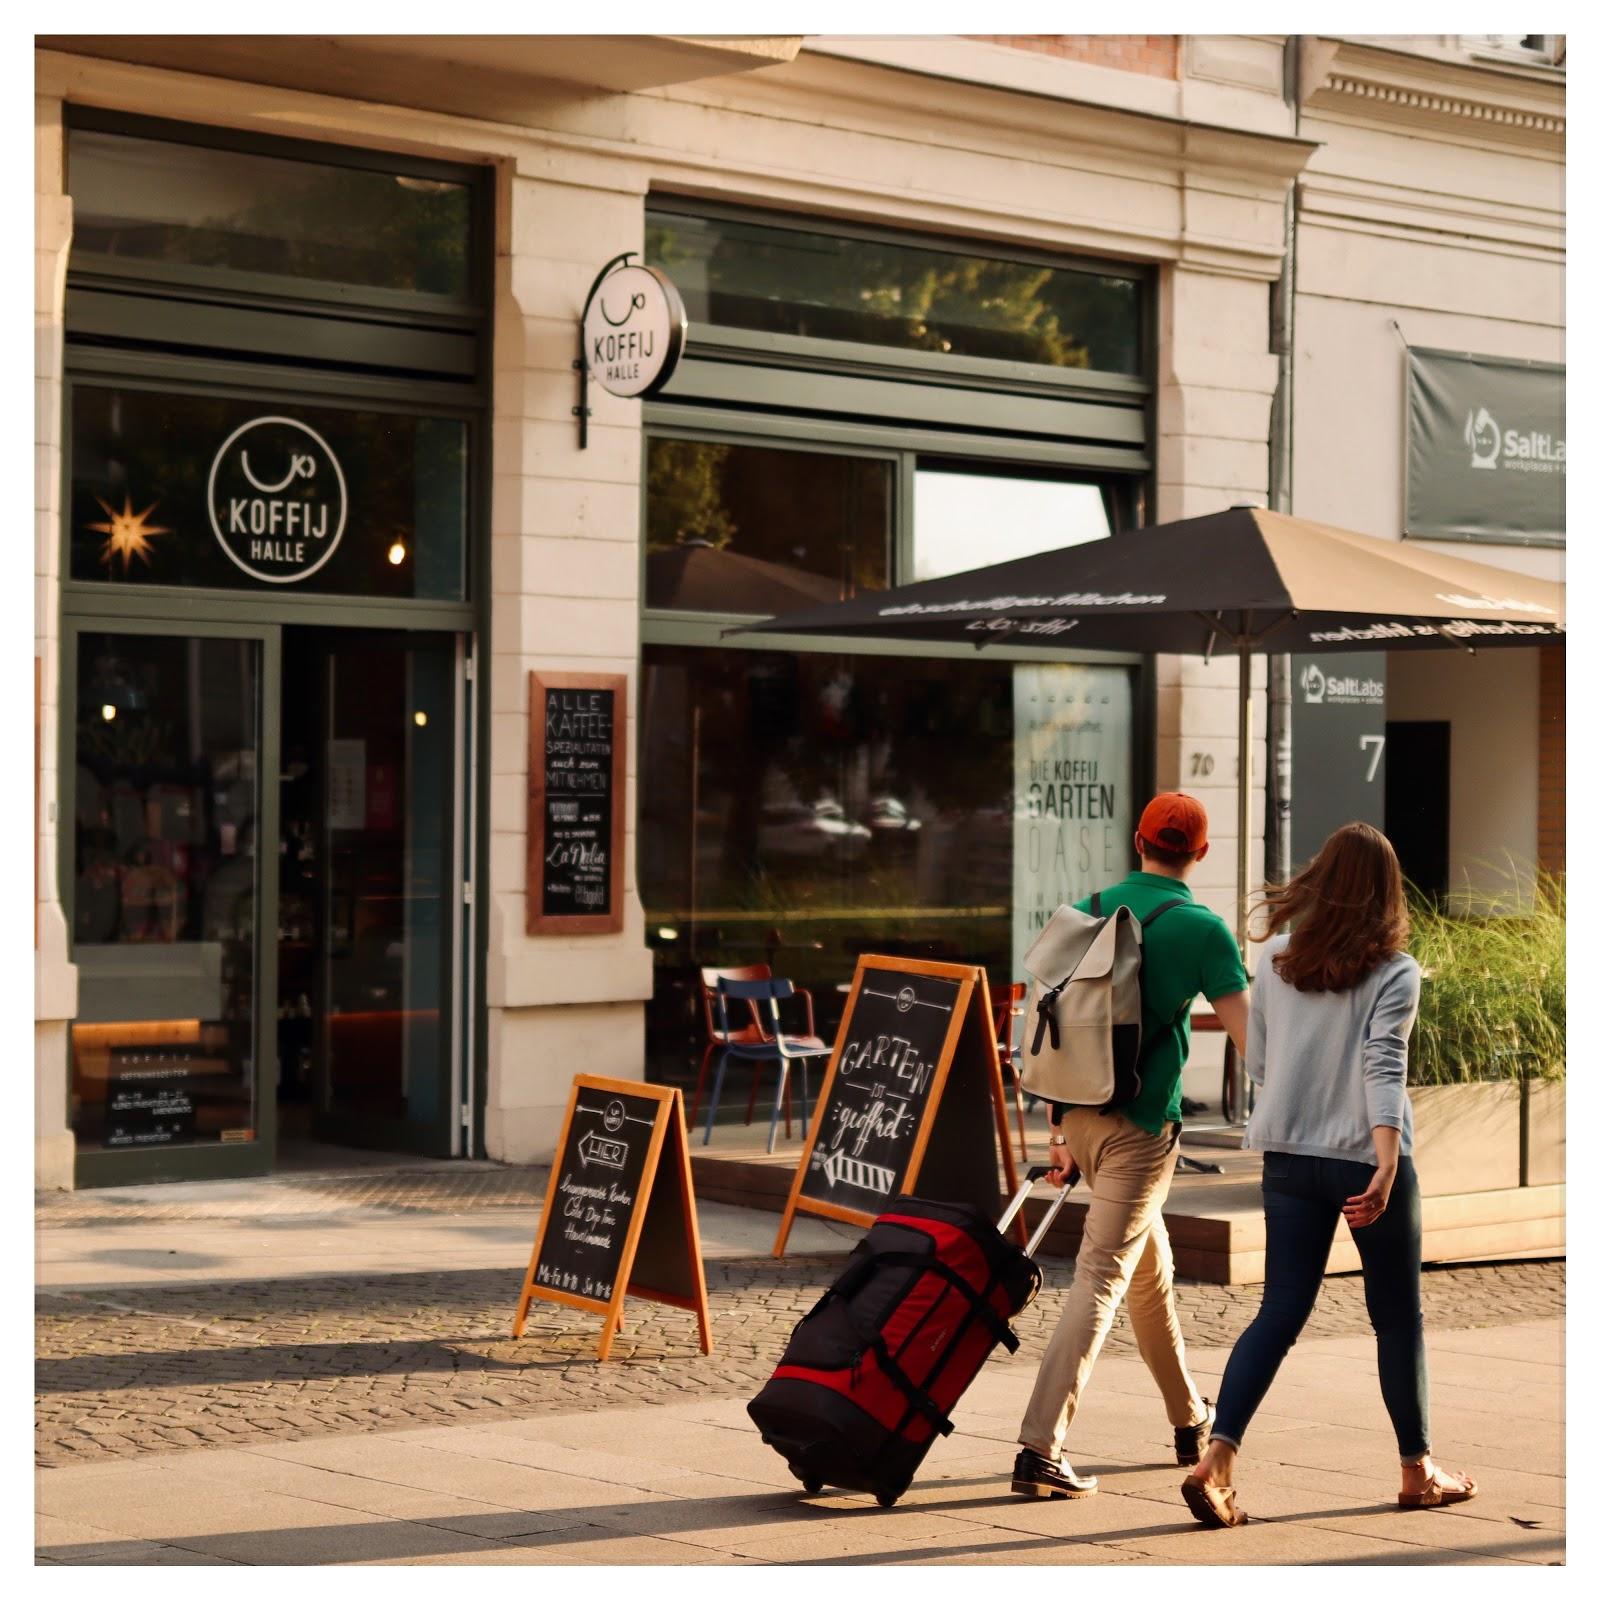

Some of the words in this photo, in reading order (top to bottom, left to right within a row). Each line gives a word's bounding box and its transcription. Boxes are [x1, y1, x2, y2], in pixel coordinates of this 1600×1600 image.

[594, 330, 654, 364] KOFFIJ
[607, 363, 639, 381] HALLE
[230, 498, 328, 539] KOFFIJ
[251, 539, 305, 562] HALLE
[1326, 677, 1384, 697] SaltLabs
[548, 694, 601, 711] ALLE
[546, 712, 613, 739] KAFFEE-
[551, 757, 575, 769] auch
[1030, 760, 1049, 781] DIE
[1054, 760, 1098, 781] KOFFIJ
[1028, 783, 1114, 820] GARTEN
[1029, 826, 1113, 873] OASE
[841, 1036, 934, 1094] GARTEN
[589, 1140, 621, 1161] HIER
